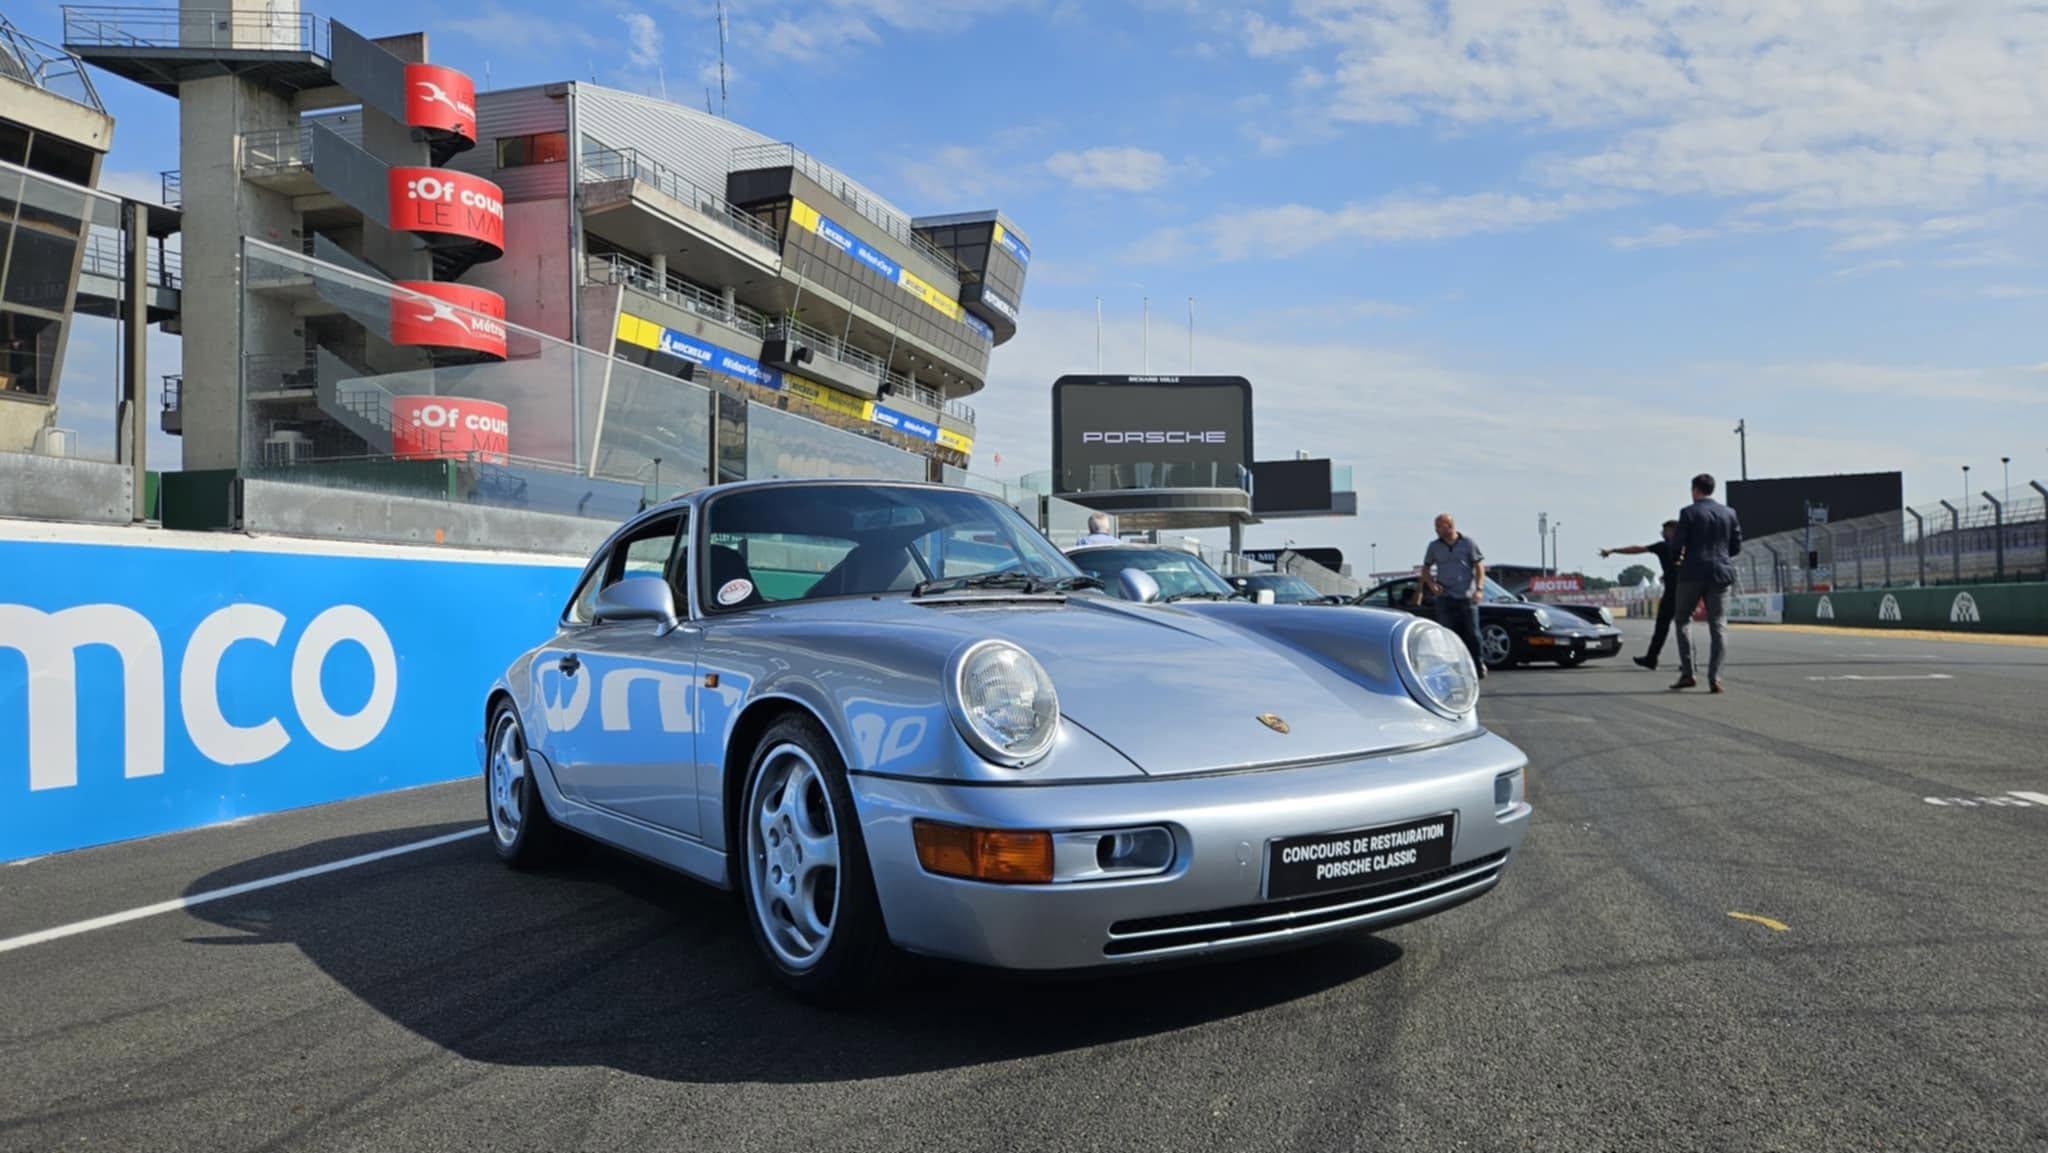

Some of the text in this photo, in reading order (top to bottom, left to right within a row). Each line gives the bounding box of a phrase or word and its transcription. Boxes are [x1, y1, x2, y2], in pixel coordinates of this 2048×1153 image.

[417, 202, 452, 226] LE
[1083, 431, 1226, 444] PORSCHE
[1533, 580, 1579, 591] MOTUL
[1283, 823, 1444, 863] CONCOURS DE RESTAURATION
[1317, 849, 1417, 880] PORSCHE CLASSIC
